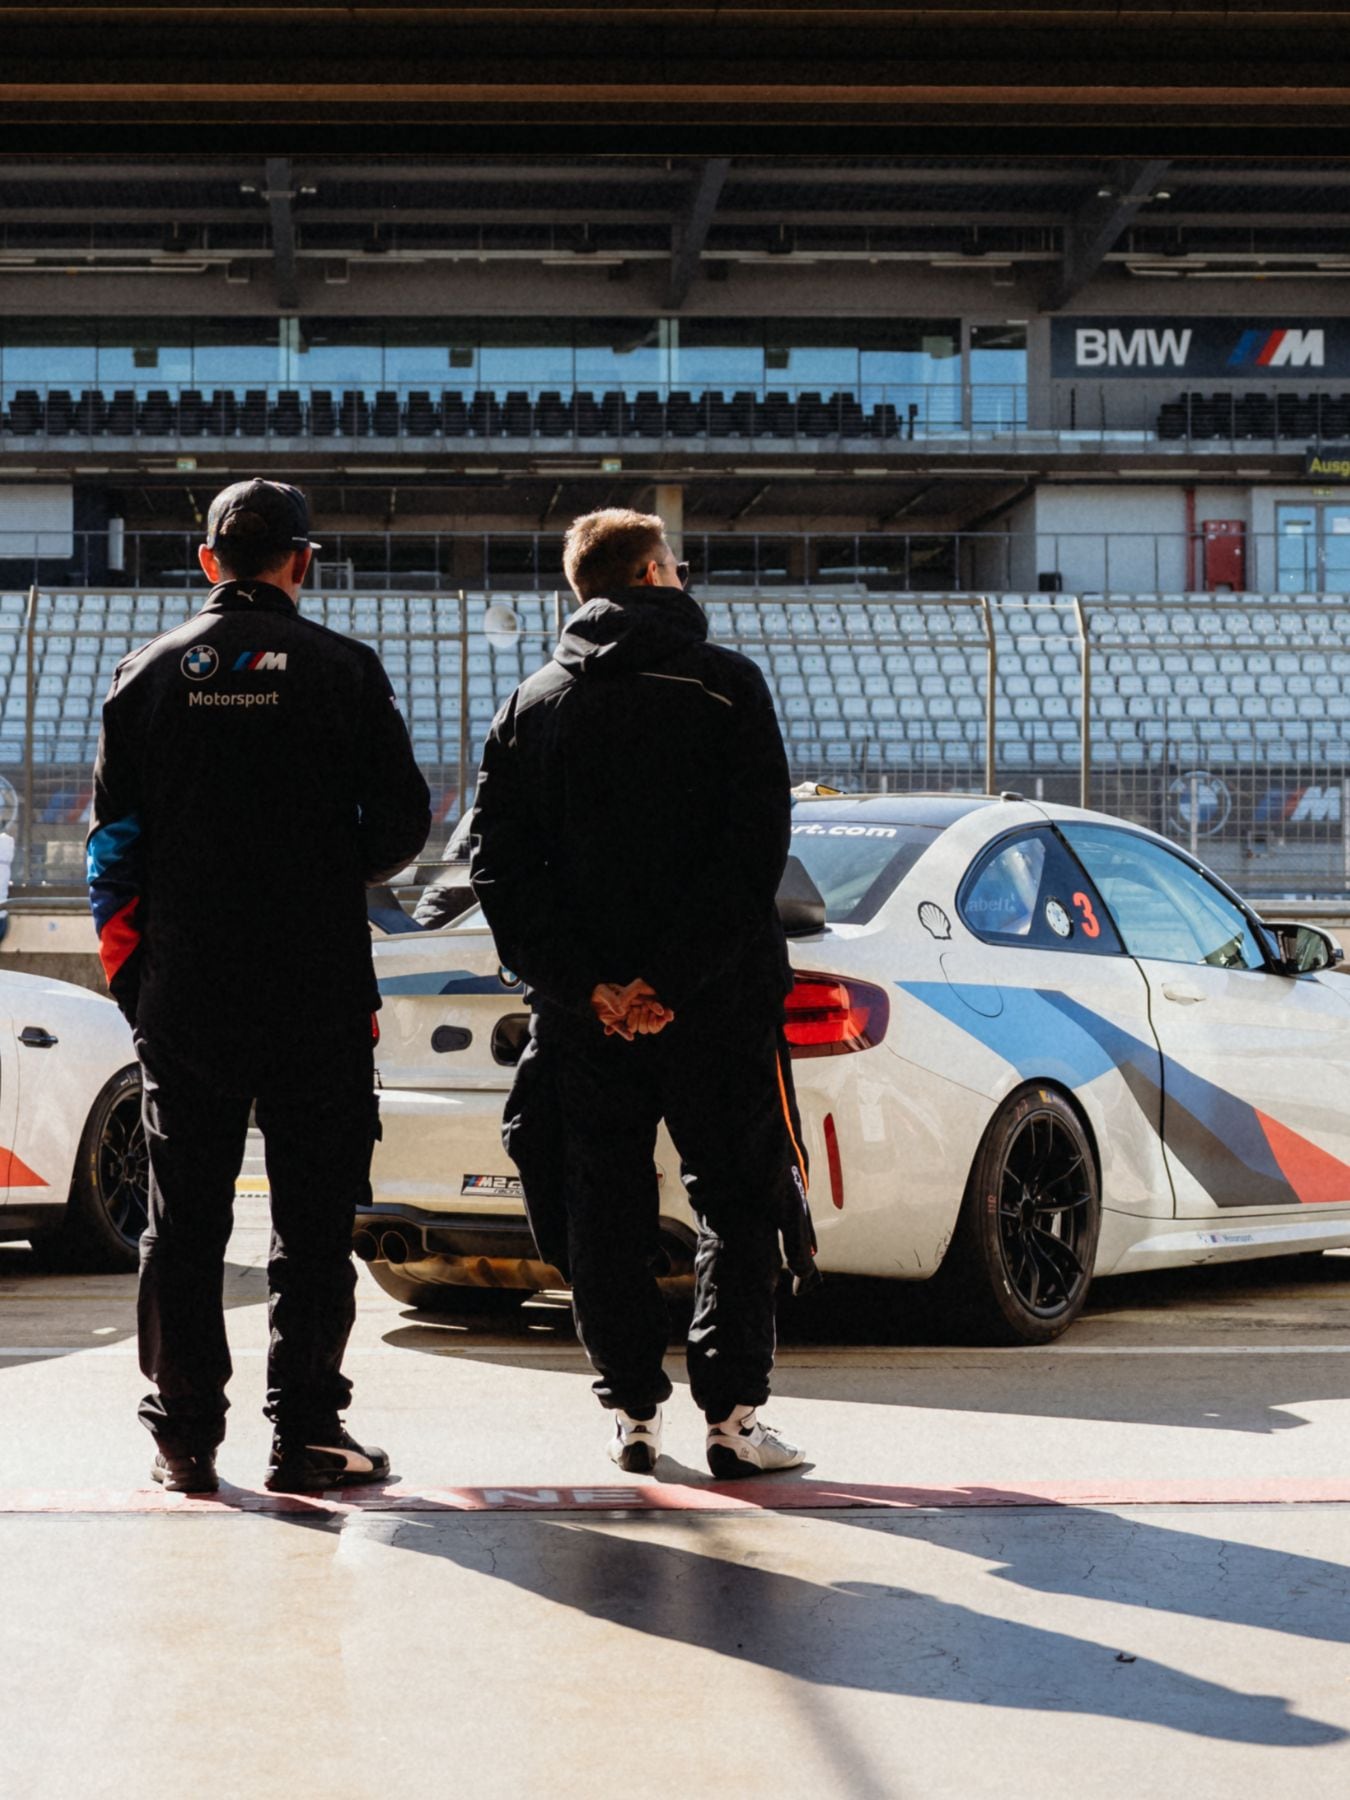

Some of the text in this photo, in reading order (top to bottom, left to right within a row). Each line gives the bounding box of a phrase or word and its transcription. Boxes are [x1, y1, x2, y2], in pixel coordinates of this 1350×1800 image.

[1075, 328, 1192, 366] BMW
[188, 691, 279, 707] Motorsport
[790, 824, 897, 838] rt.com
[1072, 892, 1100, 938] 3
